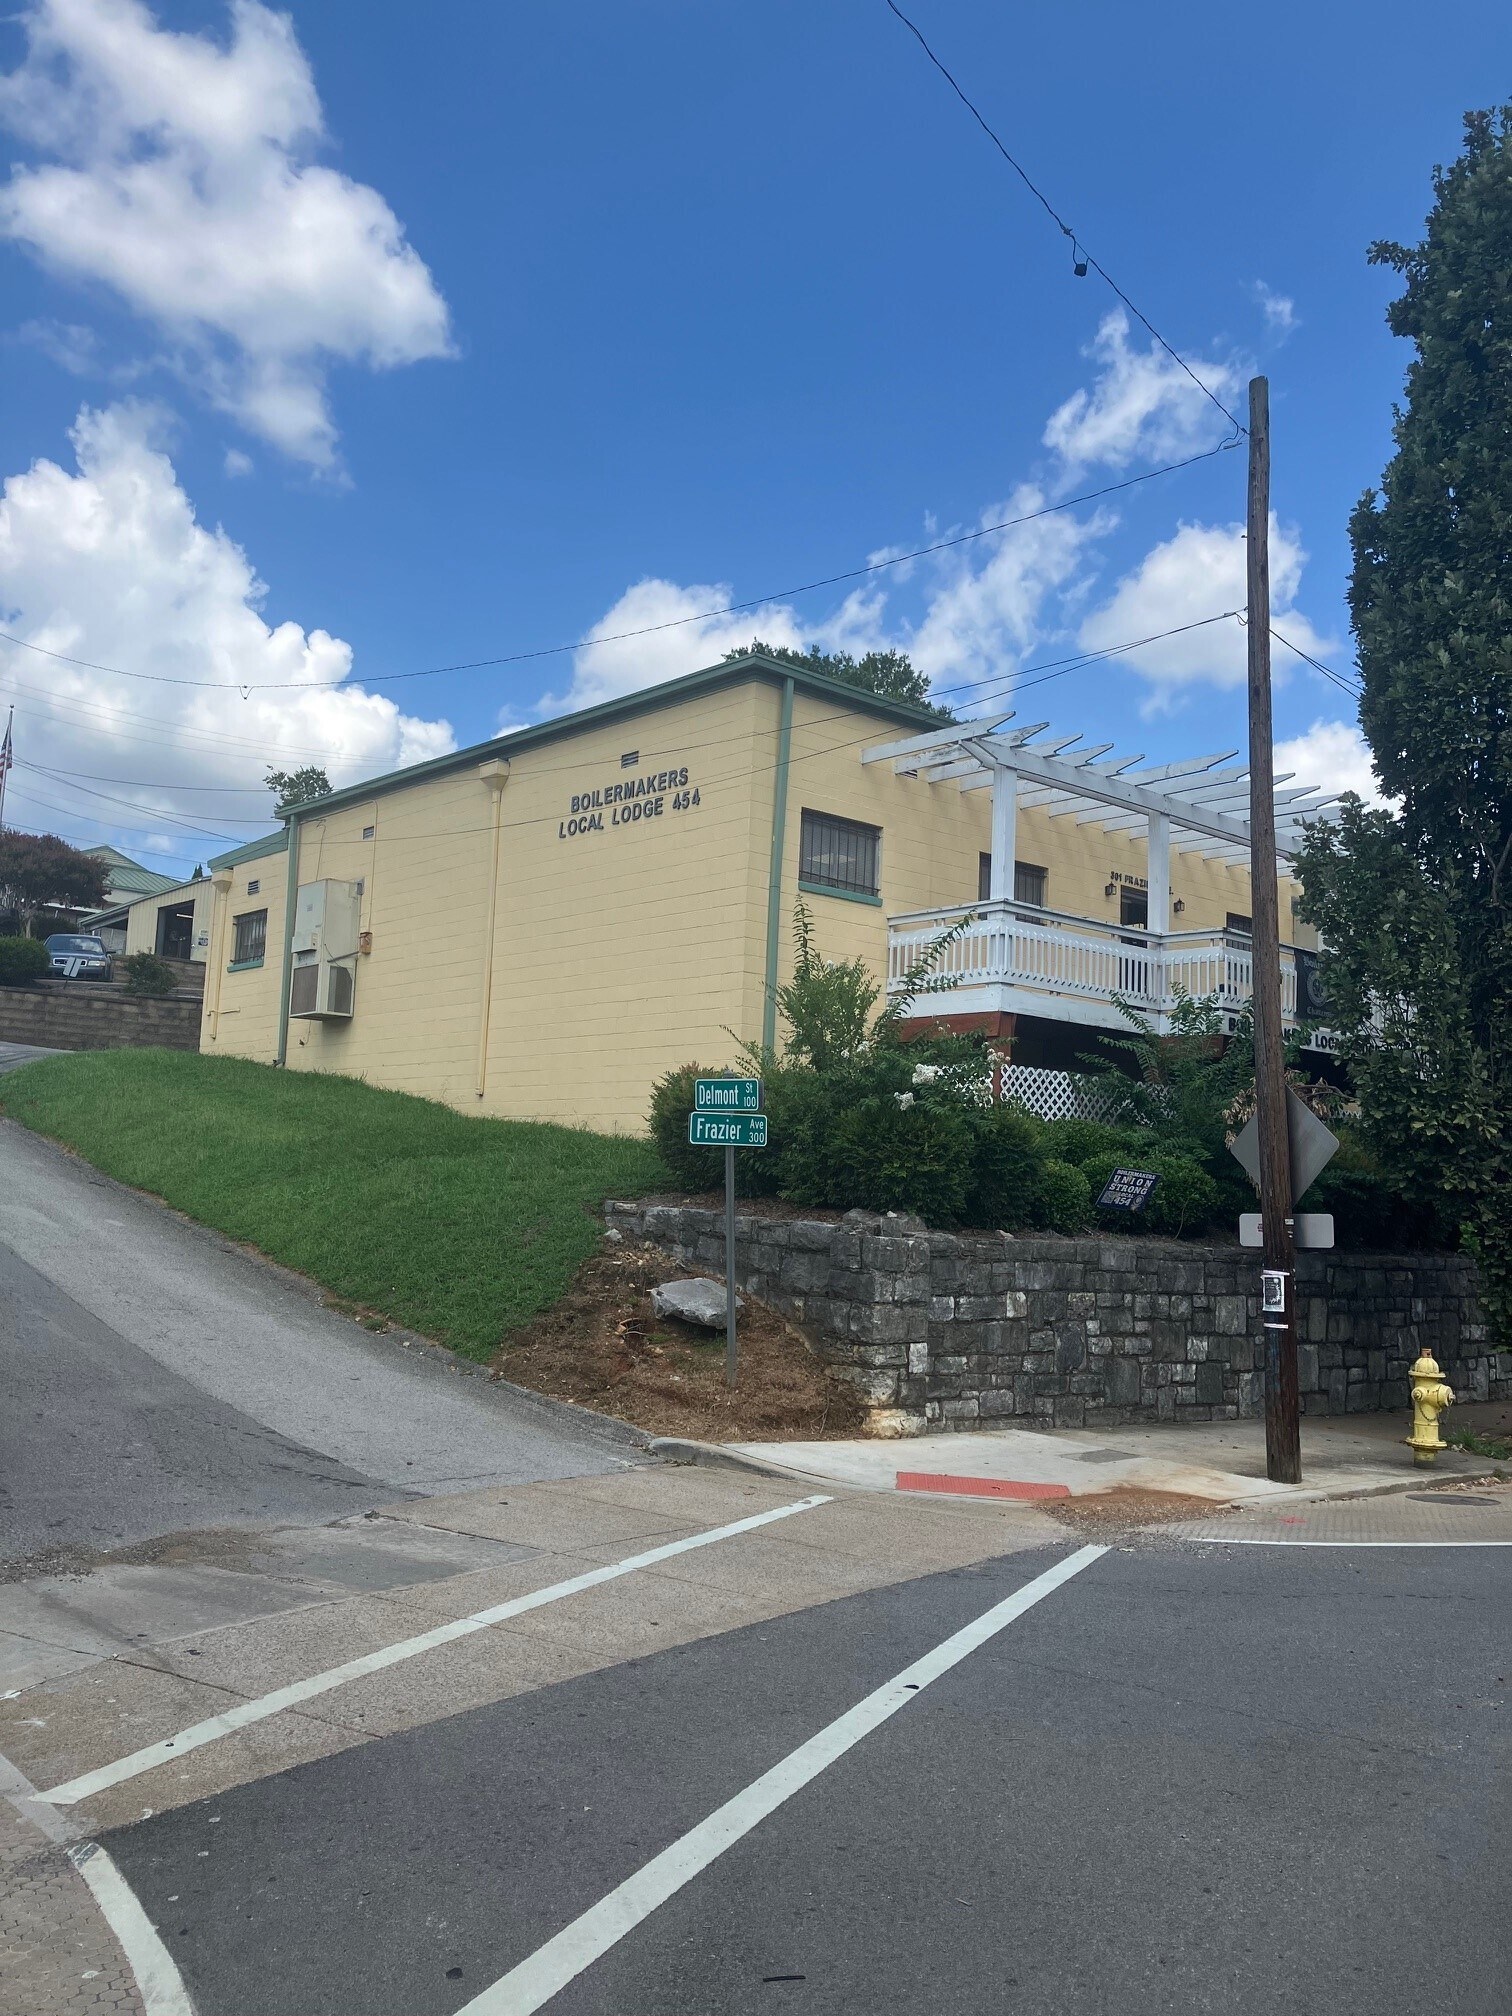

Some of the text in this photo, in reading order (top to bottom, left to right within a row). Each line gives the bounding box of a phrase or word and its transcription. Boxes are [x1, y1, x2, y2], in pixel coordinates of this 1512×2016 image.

[570, 767, 689, 813] BOILERMAKERS
[558, 788, 701, 839] LOCAL LODGE 454
[1110, 870, 1122, 882] 301
[698, 1082, 754, 1105] Delmont St
[743, 1096, 757, 1107] 100
[696, 1117, 764, 1140] Frazier Ave
[748, 1132, 765, 1143] 300
[1116, 1169, 1157, 1180] BOILERMAKERS
[1113, 1174, 1154, 1189] UNION
[1108, 1182, 1149, 1196] STRONG
[1117, 1191, 1135, 1199] LOCAL
[1113, 1196, 1132, 1206] 454
